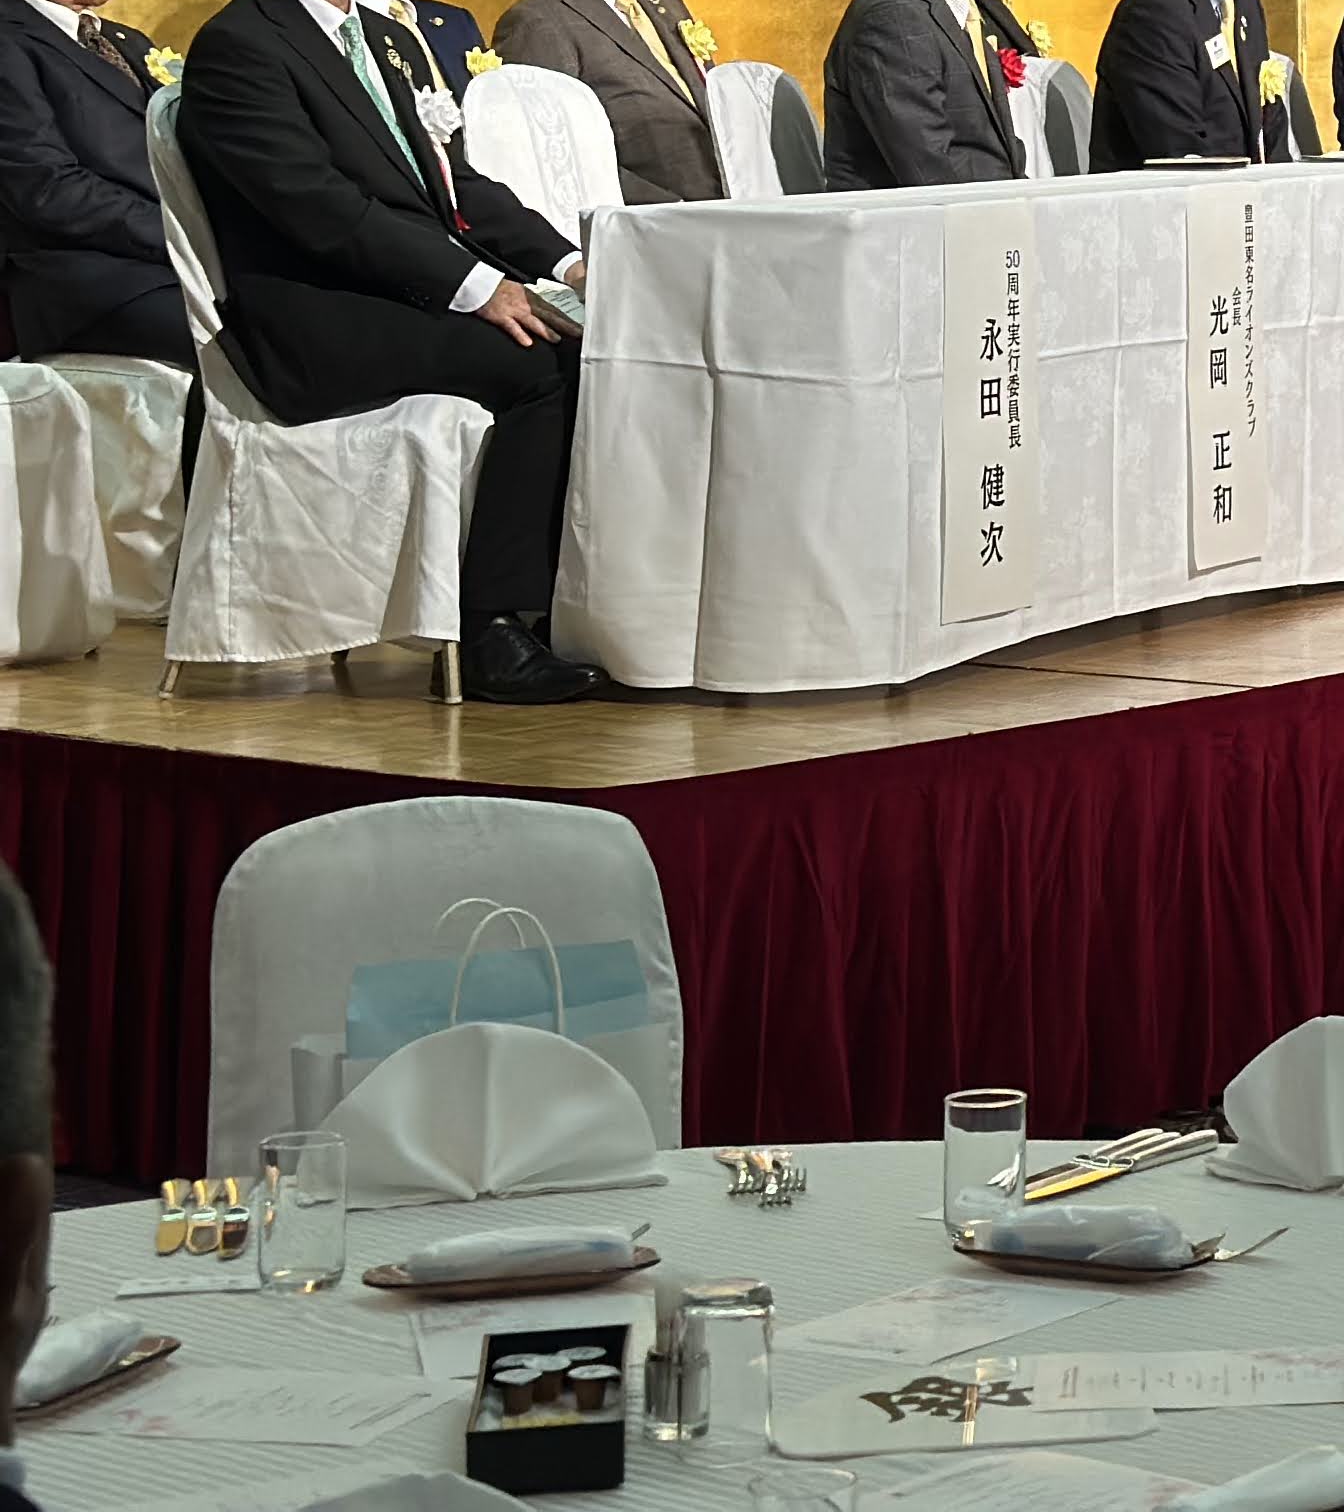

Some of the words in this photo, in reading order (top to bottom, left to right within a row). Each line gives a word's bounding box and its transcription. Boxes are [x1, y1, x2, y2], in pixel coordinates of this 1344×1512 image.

[1005, 249, 1022, 450] 50周年実行委員長
[1210, 296, 1228, 389] 光岡
[1232, 286, 1242, 326] 会長
[1244, 204, 1257, 437] 豊田東名ライオンズクラブ
[980, 319, 1003, 418] 永田
[981, 464, 1005, 566] 健次
[1213, 431, 1231, 523] 正和
